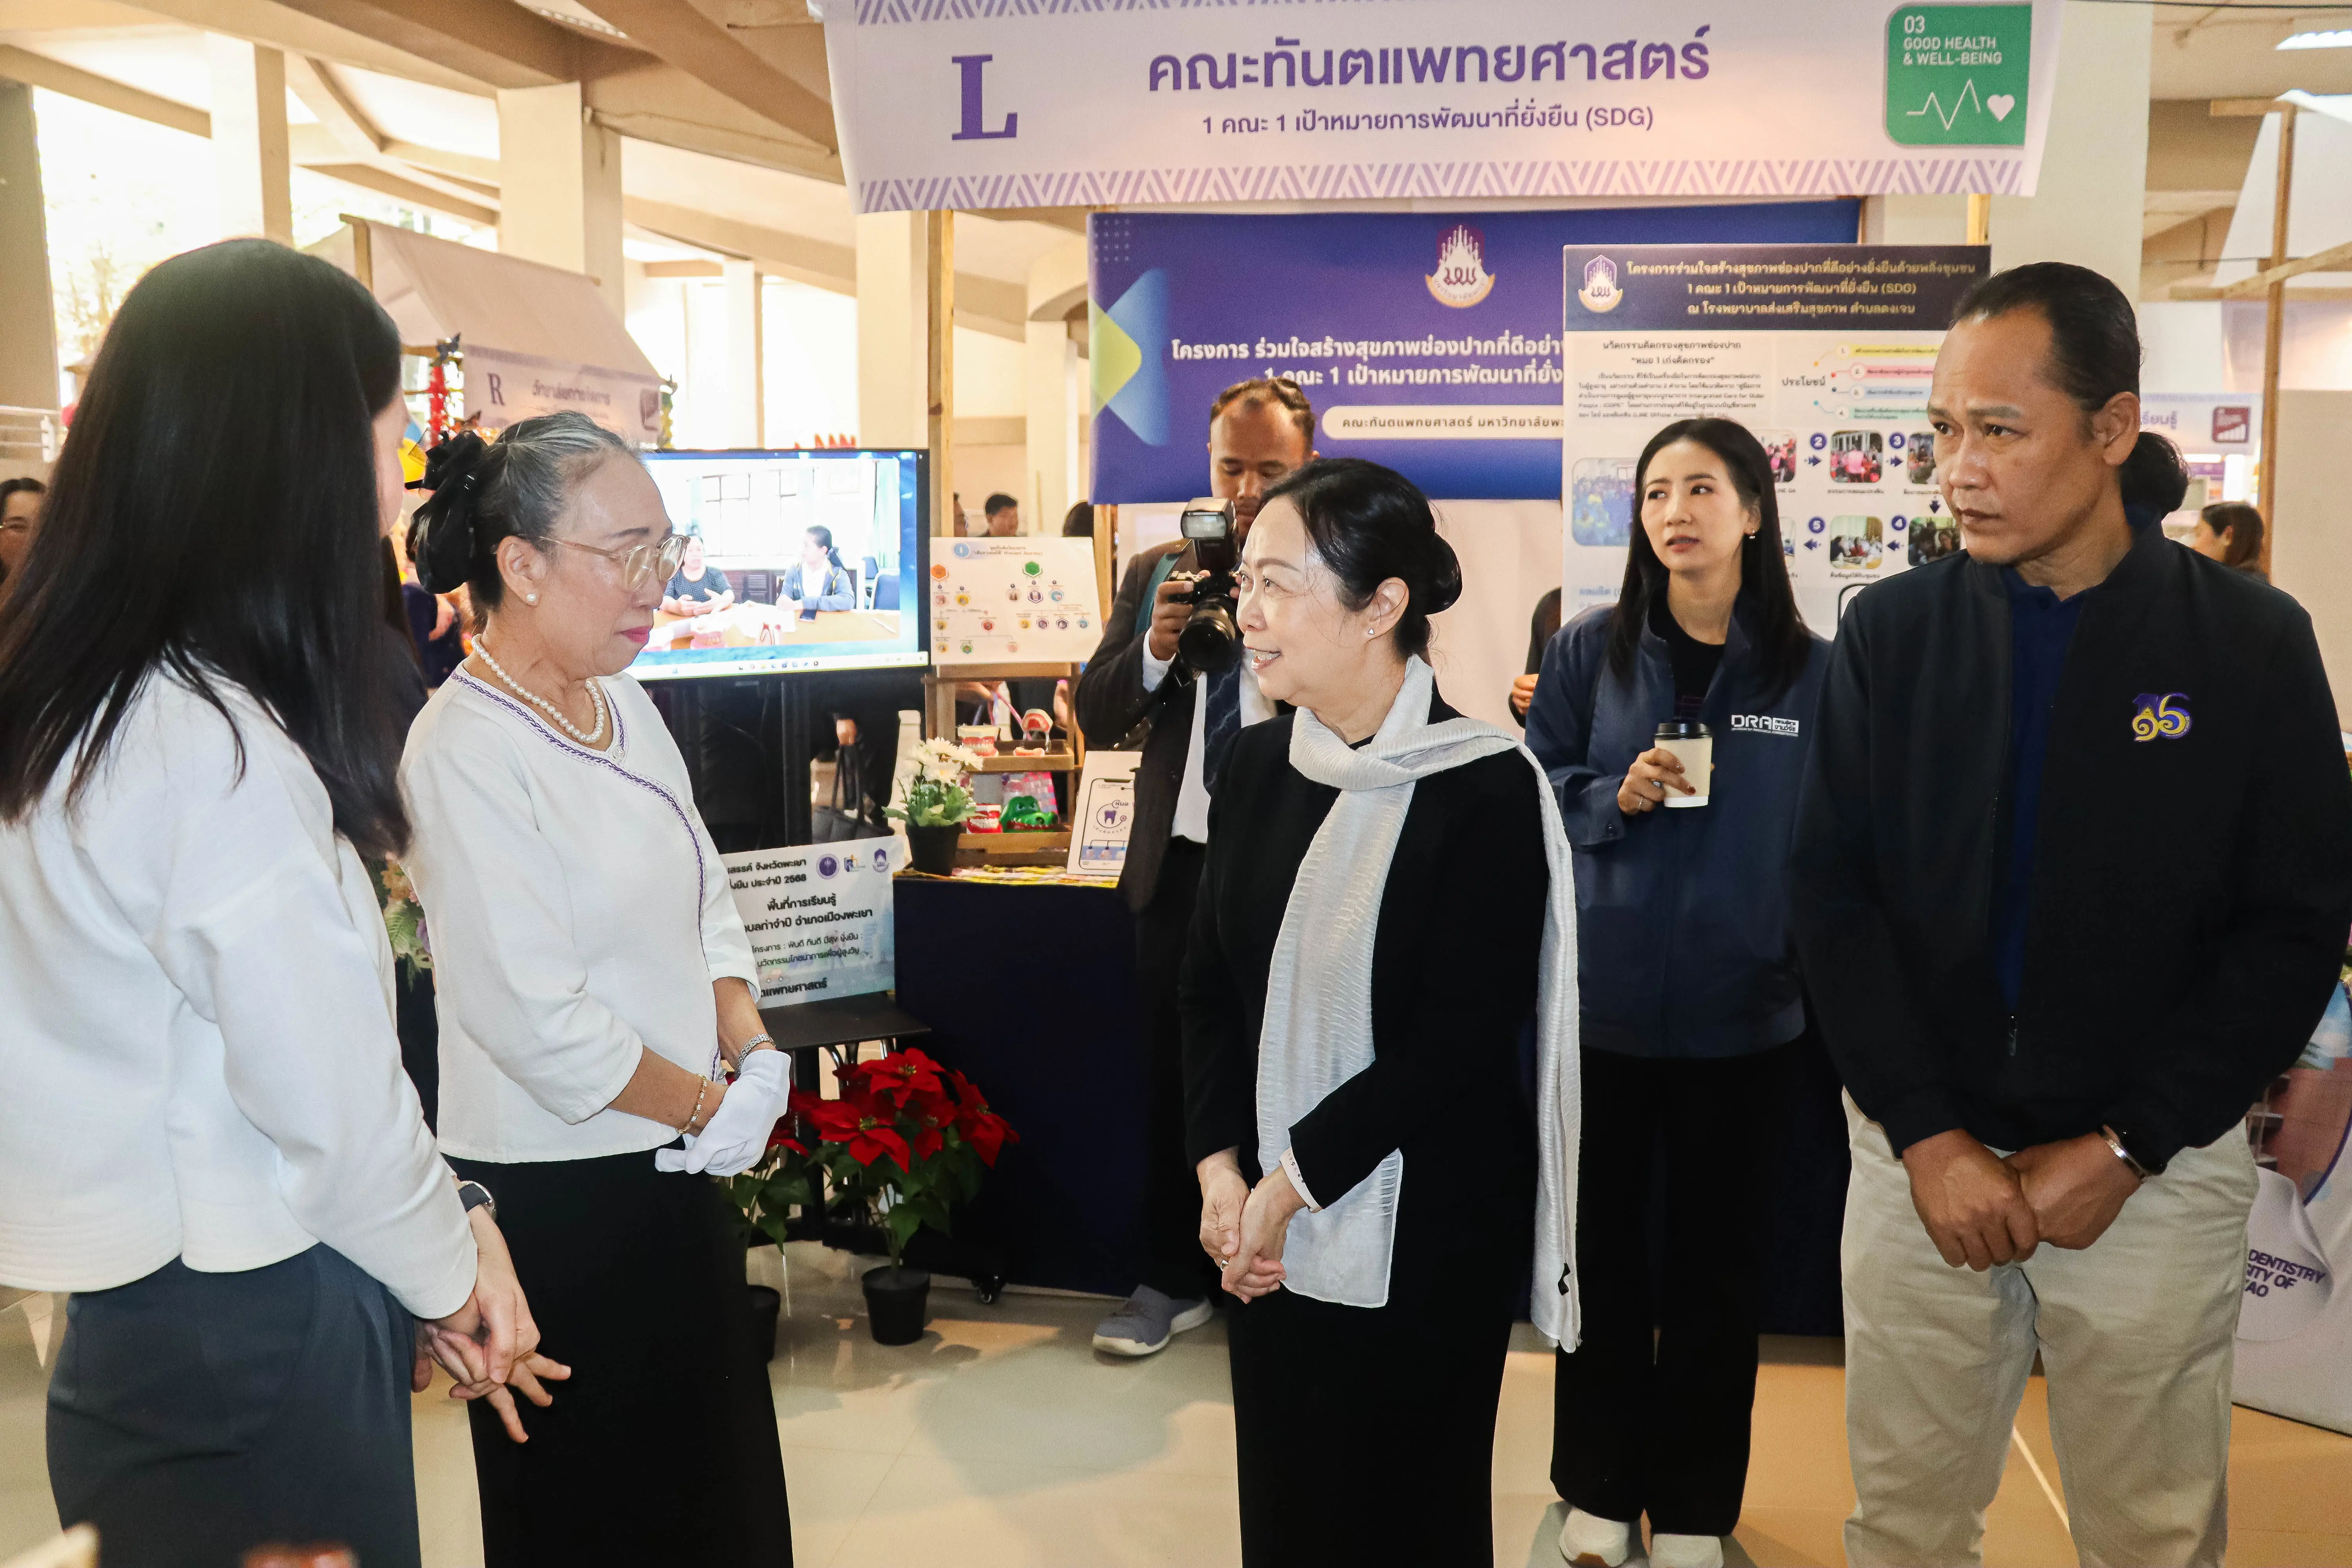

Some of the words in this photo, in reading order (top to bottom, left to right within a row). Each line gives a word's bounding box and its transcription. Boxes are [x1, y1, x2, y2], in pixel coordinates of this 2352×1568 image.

[1904, 15, 1926, 34] 03
[1903, 37, 1941, 50] GOOD
[1945, 36, 1997, 50] HEALTH
[1149, 24, 1710, 91] คณะทันตแพทยศาสตร์
[1903, 53, 1913, 65] &
[1916, 51, 2002, 65] WELL-BEING
[951, 55, 1017, 140] L
[1203, 116, 1212, 133] 1
[1222, 117, 1268, 133] คณะ
[1276, 114, 1285, 132] 1
[1296, 98, 1578, 131] เป้าหมายการพัฒนาที่ยั่งยืน
[1586, 106, 1654, 131] (SDG)
[1688, 283, 1693, 294] 1
[1695, 284, 1722, 294] คณะ
[1726, 283, 1730, 294] 1
[1733, 277, 1878, 294] เป้าหมายการพัฒนาที่ยั่งยืน
[1881, 283, 1917, 295] (SDG)
[1687, 304, 1699, 314] ณ
[1702, 300, 1847, 318] โรงพยาบาลส่งเสริมสุขภาพ
[1171, 338, 1249, 360] โครงการ
[1254, 329, 1563, 361] ร่วมใจสร้างสุขภาพช่องปากที่ดีอย่า
[1603, 339, 1741, 352] นวัตกรรมคัดกรองสุขภาพช่องปาก
[1329, 366, 1339, 385] 1
[1347, 358, 1563, 385] เป้าหมายการพัฒนาที่ยั่ง
[1782, 375, 1826, 386] ประโยชน์
[488, 372, 505, 406] R
[1342, 416, 1473, 428] คณะทันตแพทยศาสตร์
[1814, 435, 1823, 446] 2
[1893, 435, 1902, 446] 3
[1895, 518, 1903, 528] 4
[1731, 715, 1772, 730] DRA
[767, 893, 837, 911] พื้นที่การเรียนรู้
[795, 908, 873, 927] อำเภอเมืองพะเยา
[2248, 1249, 2326, 1284] DENTISTRY
[2245, 1279, 2270, 1298] AO
[2274, 1274, 2298, 1289] OF
